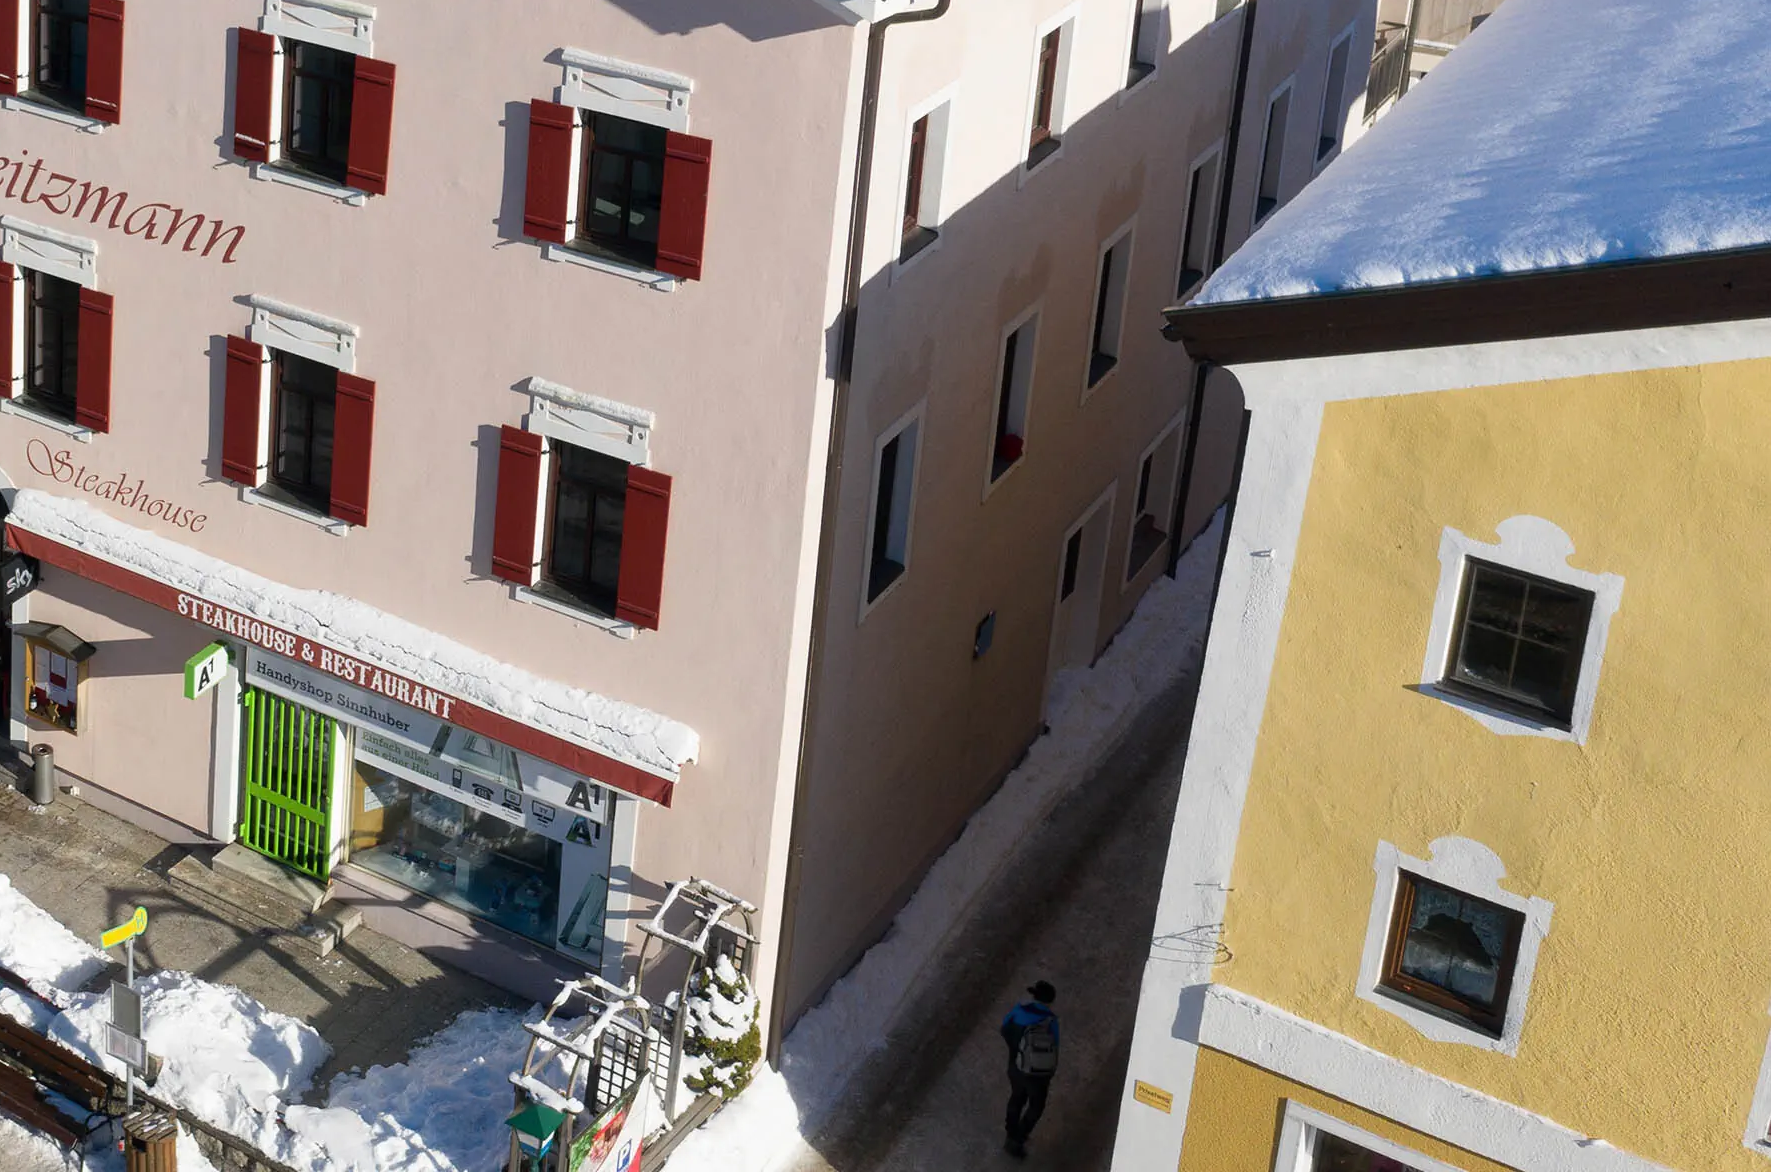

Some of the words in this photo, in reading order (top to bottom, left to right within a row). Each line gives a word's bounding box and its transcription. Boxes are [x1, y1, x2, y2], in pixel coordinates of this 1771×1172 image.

[26, 439, 207, 532] Steakhouse
[7, 568, 33, 595] sky
[177, 594, 297, 657] STEAKHOUSE
[301, 643, 314, 663] &
[320, 647, 456, 720] RESTAURANT
[198, 657, 214, 692] A1
[256, 661, 333, 703] Handyshop
[337, 694, 410, 732] Sinnhuber
[362, 731, 401, 755] Einfach
[404, 749, 430, 766] alles
[362, 744, 380, 757] aus
[382, 752, 410, 767] einer
[412, 762, 439, 780] Hand
[565, 779, 600, 812] A1
